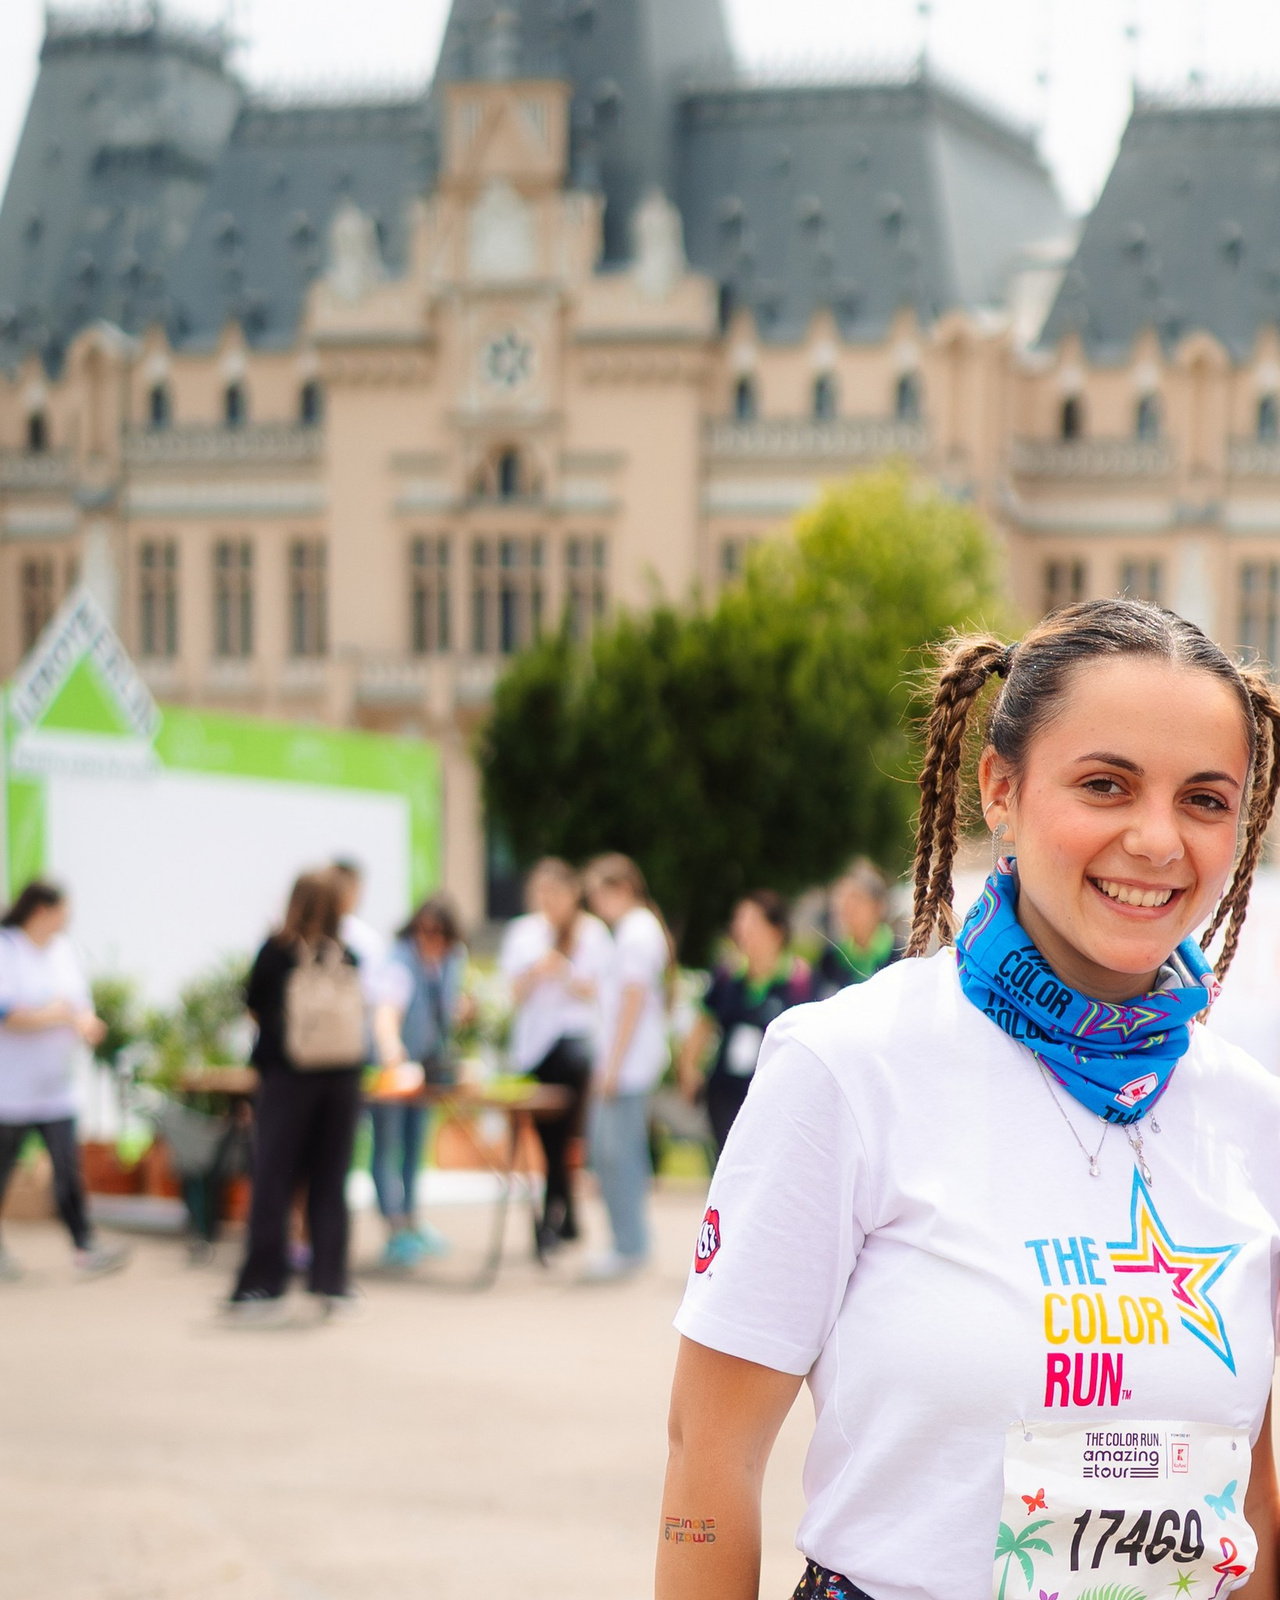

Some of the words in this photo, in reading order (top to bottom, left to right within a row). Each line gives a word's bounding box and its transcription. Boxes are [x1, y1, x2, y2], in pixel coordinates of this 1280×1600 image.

[999, 950, 1074, 1020] COLOR
[1025, 1236, 1106, 1286] THE
[1044, 1293, 1169, 1344] COLOR
[1044, 1353, 1123, 1407] RUN
[1085, 1432, 1104, 1446] THE
[1105, 1432, 1138, 1446] COLOR
[1083, 1447, 1159, 1466] amazing
[1094, 1464, 1129, 1478] tour
[664, 1526, 716, 1544] amazing
[680, 1518, 706, 1531] tour
[1070, 1509, 1205, 1571] 17469
